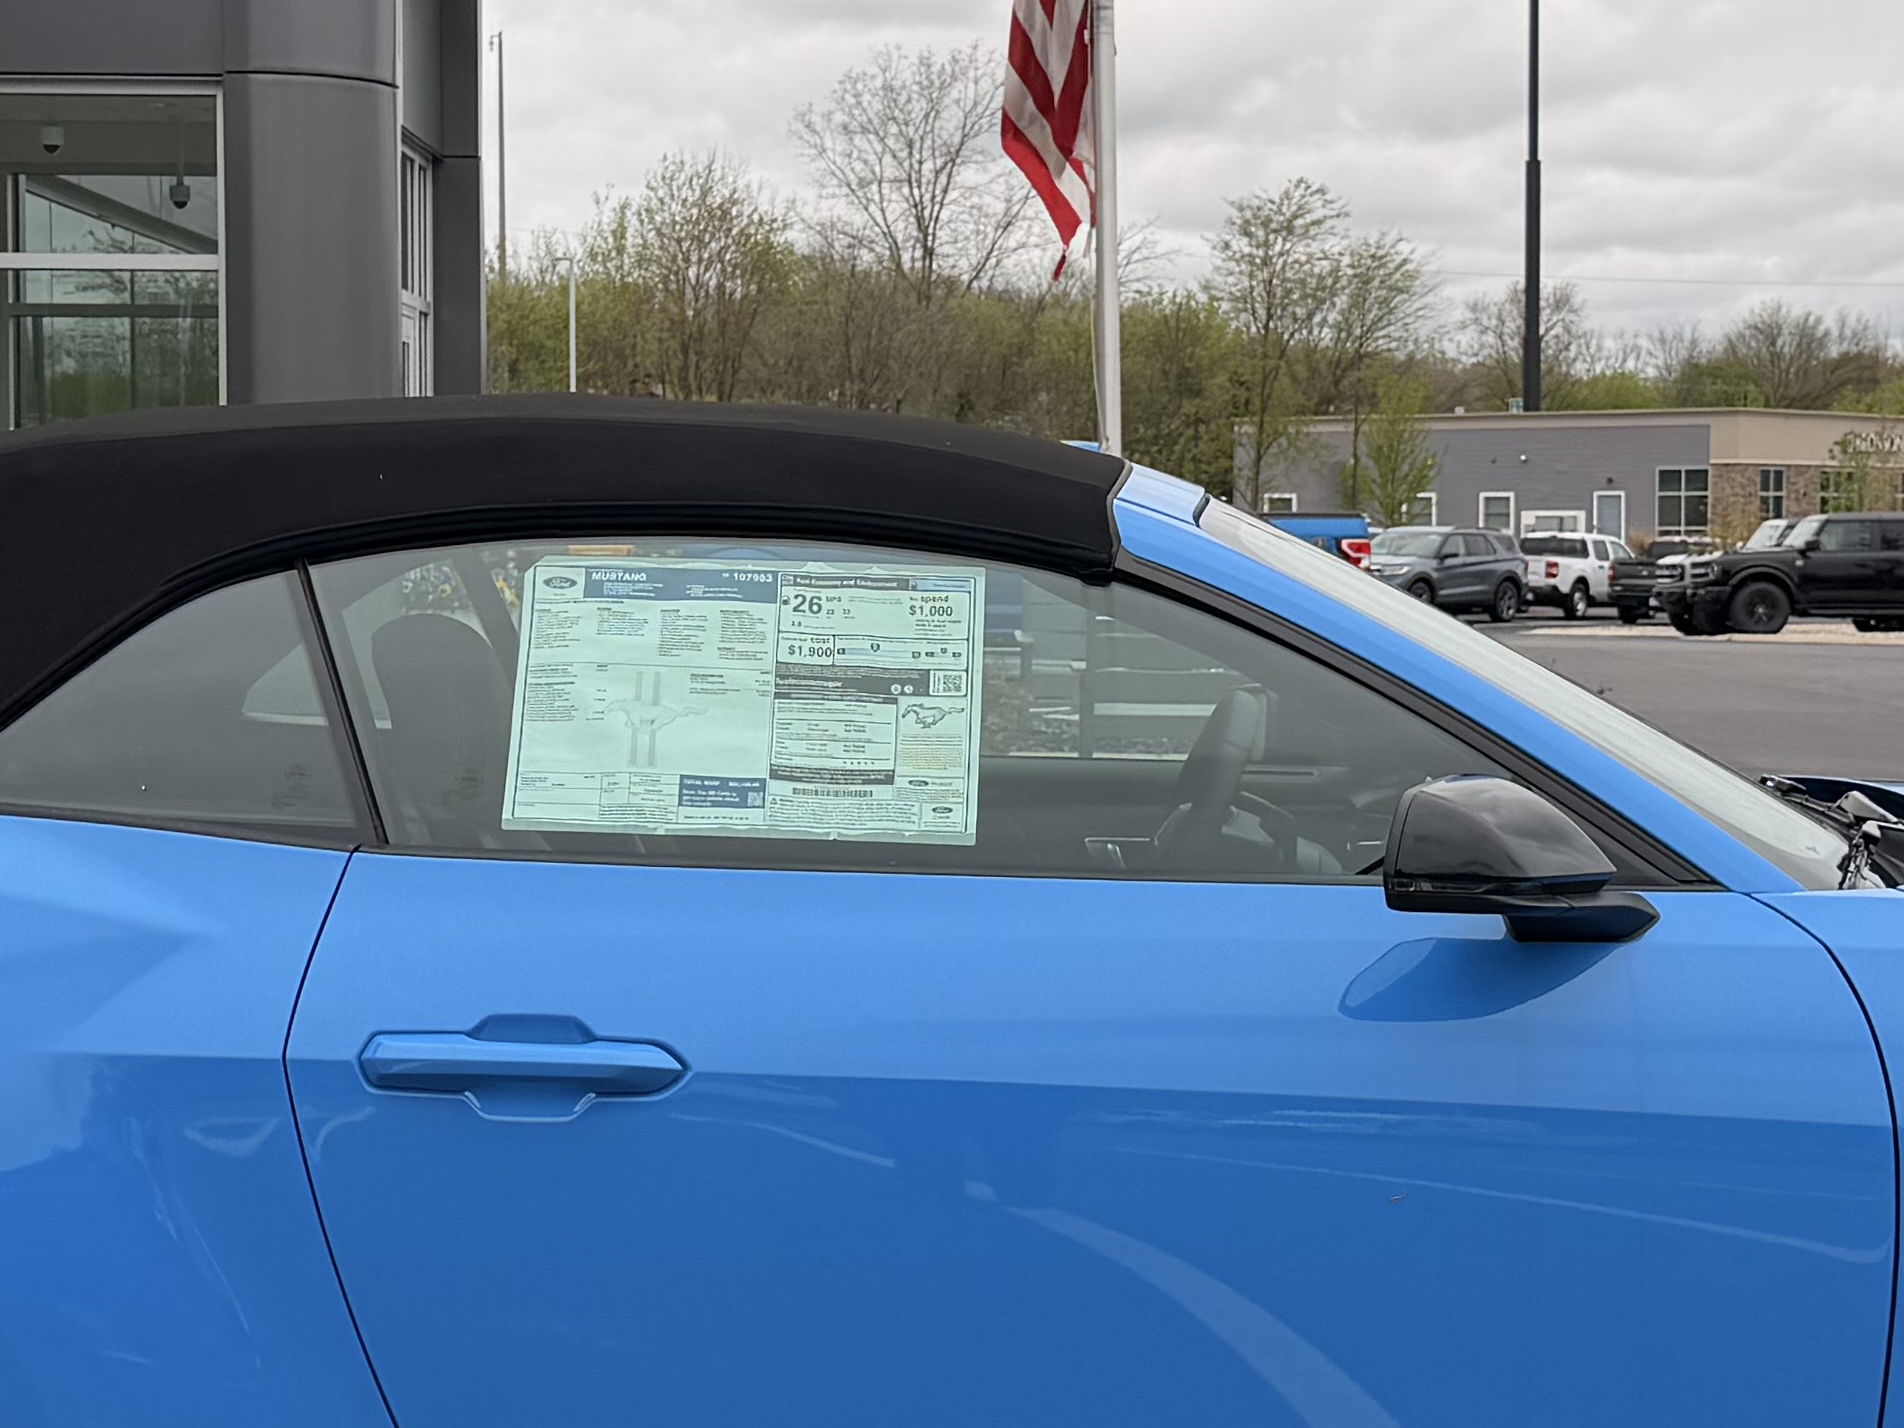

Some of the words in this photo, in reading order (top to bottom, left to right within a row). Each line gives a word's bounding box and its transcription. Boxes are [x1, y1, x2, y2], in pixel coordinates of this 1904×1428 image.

[591, 572, 646, 582] MUSTANG
[792, 593, 823, 615] 26
[920, 595, 949, 604] spend
[908, 604, 953, 617] $1,000
